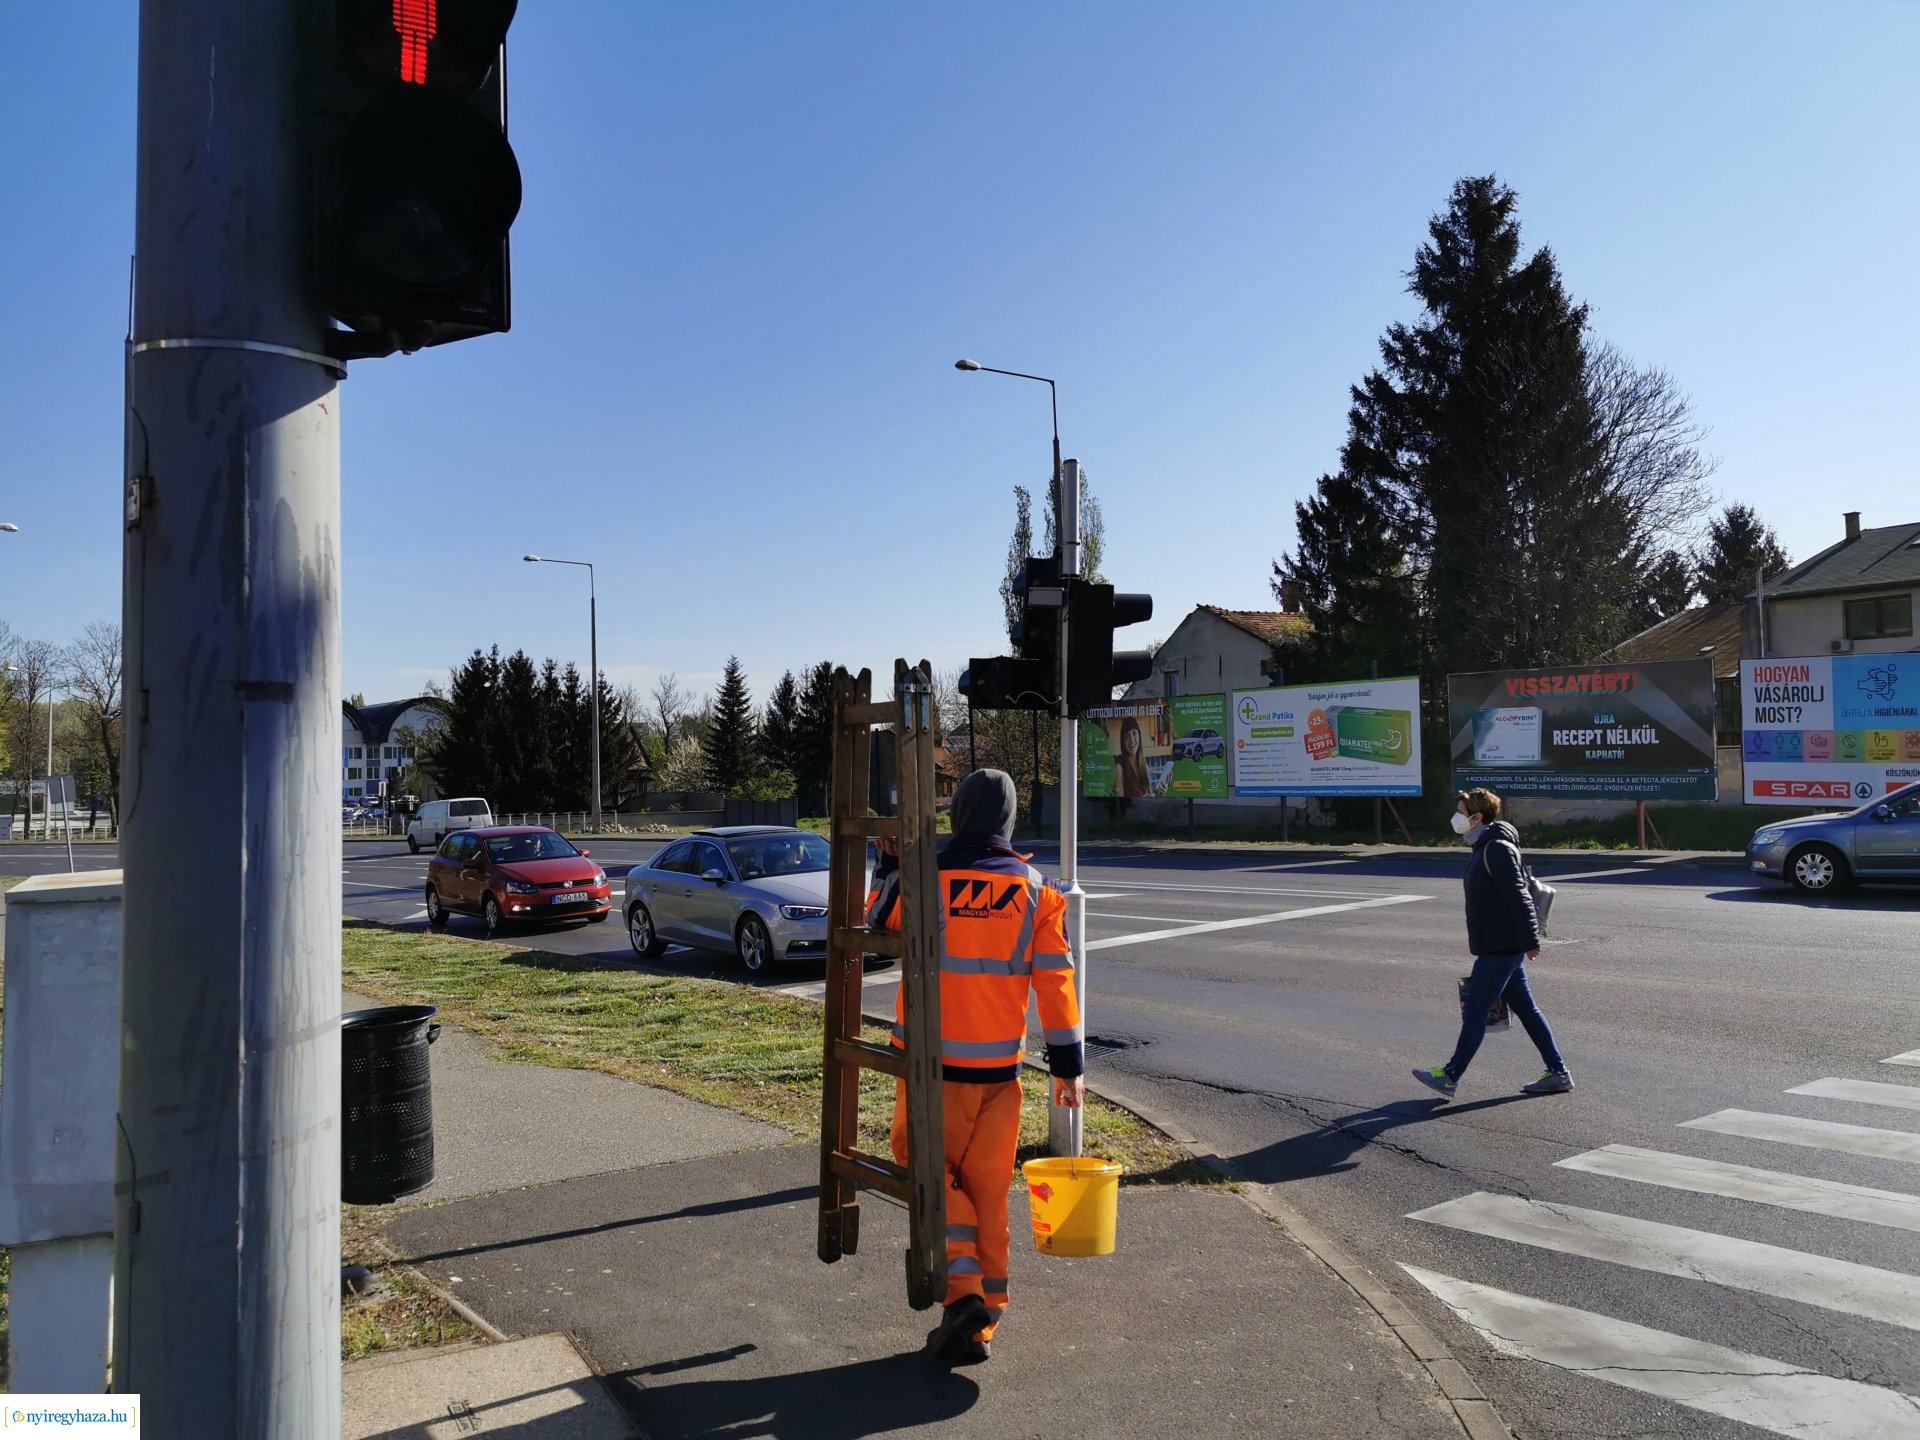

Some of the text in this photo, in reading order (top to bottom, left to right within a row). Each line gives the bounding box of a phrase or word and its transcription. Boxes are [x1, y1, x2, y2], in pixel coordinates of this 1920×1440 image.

[1754, 665, 1810, 684] HOGYAN
[1505, 669, 1637, 697] VISSZATÉRT!
[1754, 683, 1824, 704] VÁSÁROLJ
[1250, 711, 1294, 721] Grand Patika
[1594, 713, 1615, 725] ÚJRA
[1755, 706, 1803, 724] MOST?
[1553, 724, 1660, 746] RECEPT NÉLKÜL
[1585, 748, 1625, 760] KAPHATÓ!
[1771, 783, 1848, 796] SPAR
[958, 909, 989, 918] MAGYAR
